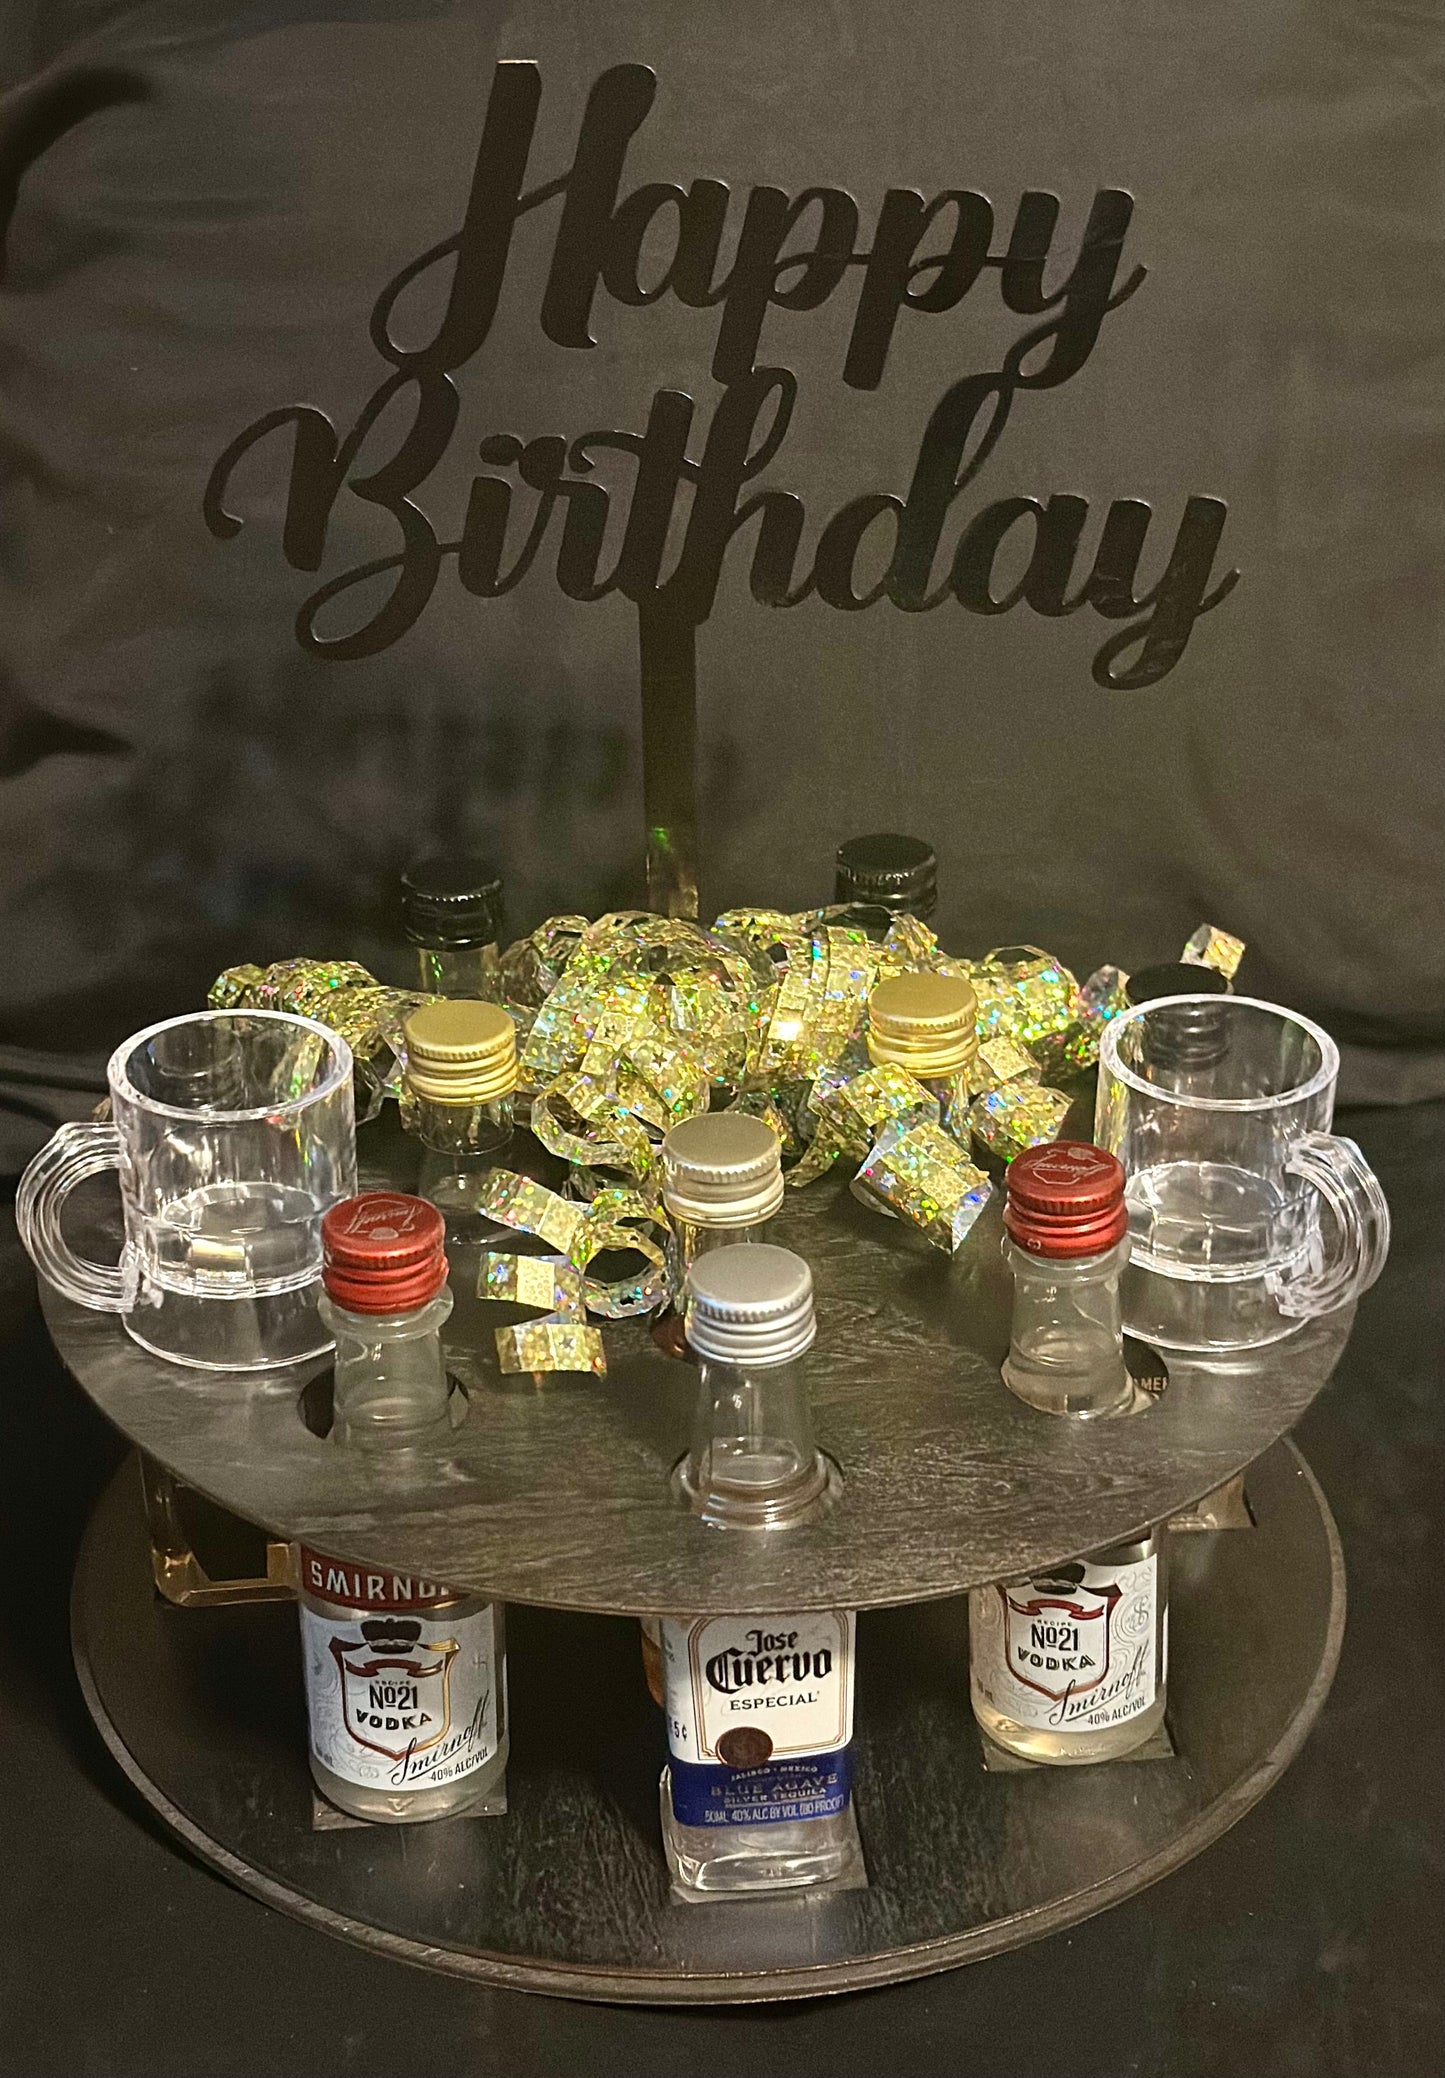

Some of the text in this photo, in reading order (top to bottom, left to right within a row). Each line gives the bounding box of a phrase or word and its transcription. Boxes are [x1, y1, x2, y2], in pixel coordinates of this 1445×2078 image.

[370, 58, 1147, 391] Happy
[204, 366, 1242, 690] Birthday
[311, 1560, 449, 1600] SMIRNO
[745, 1629, 798, 1657] Jose
[705, 1647, 832, 1695] Cuervo
[1018, 1647, 1096, 1671] VODKA
[1044, 1639, 1150, 1726] Smirnoff
[730, 1692, 818, 1711] ESPECIAL
[356, 1708, 433, 1731] VODKA
[1088, 1711, 1110, 1725] 40%
[387, 1689, 490, 1786] Smirnoff
[429, 1766, 454, 1781] 40%
[711, 1784, 763, 1796] BLUE
[772, 1772, 838, 1792] AGAVE
[731, 1767, 770, 1781] JALISCO
[780, 1765, 818, 1773] MEXICO
[724, 1787, 827, 1804] SILVER TEQUILA
[731, 1807, 750, 1822] 40%
[752, 1806, 769, 1820] ALC
[769, 1805, 782, 1819] BY
